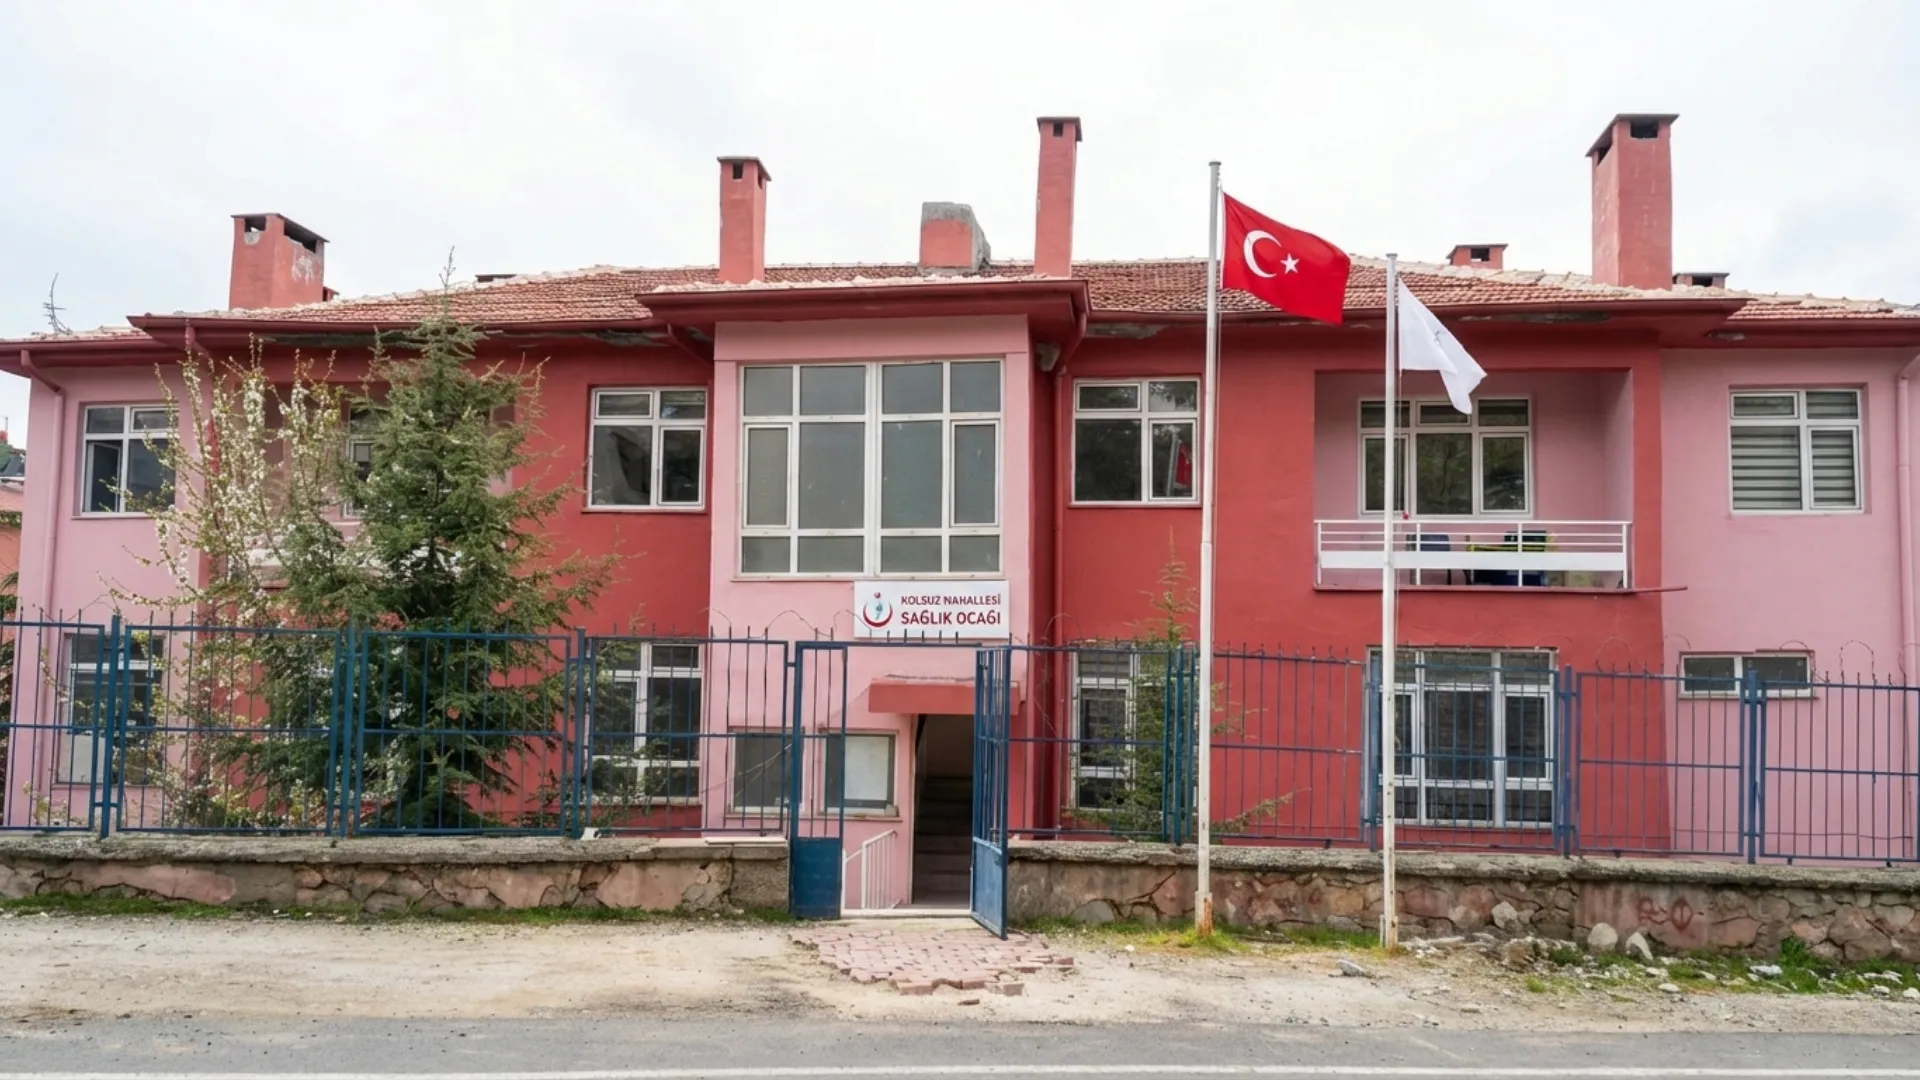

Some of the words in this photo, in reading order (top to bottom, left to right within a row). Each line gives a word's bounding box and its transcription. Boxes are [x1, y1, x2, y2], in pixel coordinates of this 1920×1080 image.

[901, 595, 941, 605] KOLSUZ
[901, 610, 952, 625] SAĞLIK
[956, 610, 1001, 625] OCAĞI
